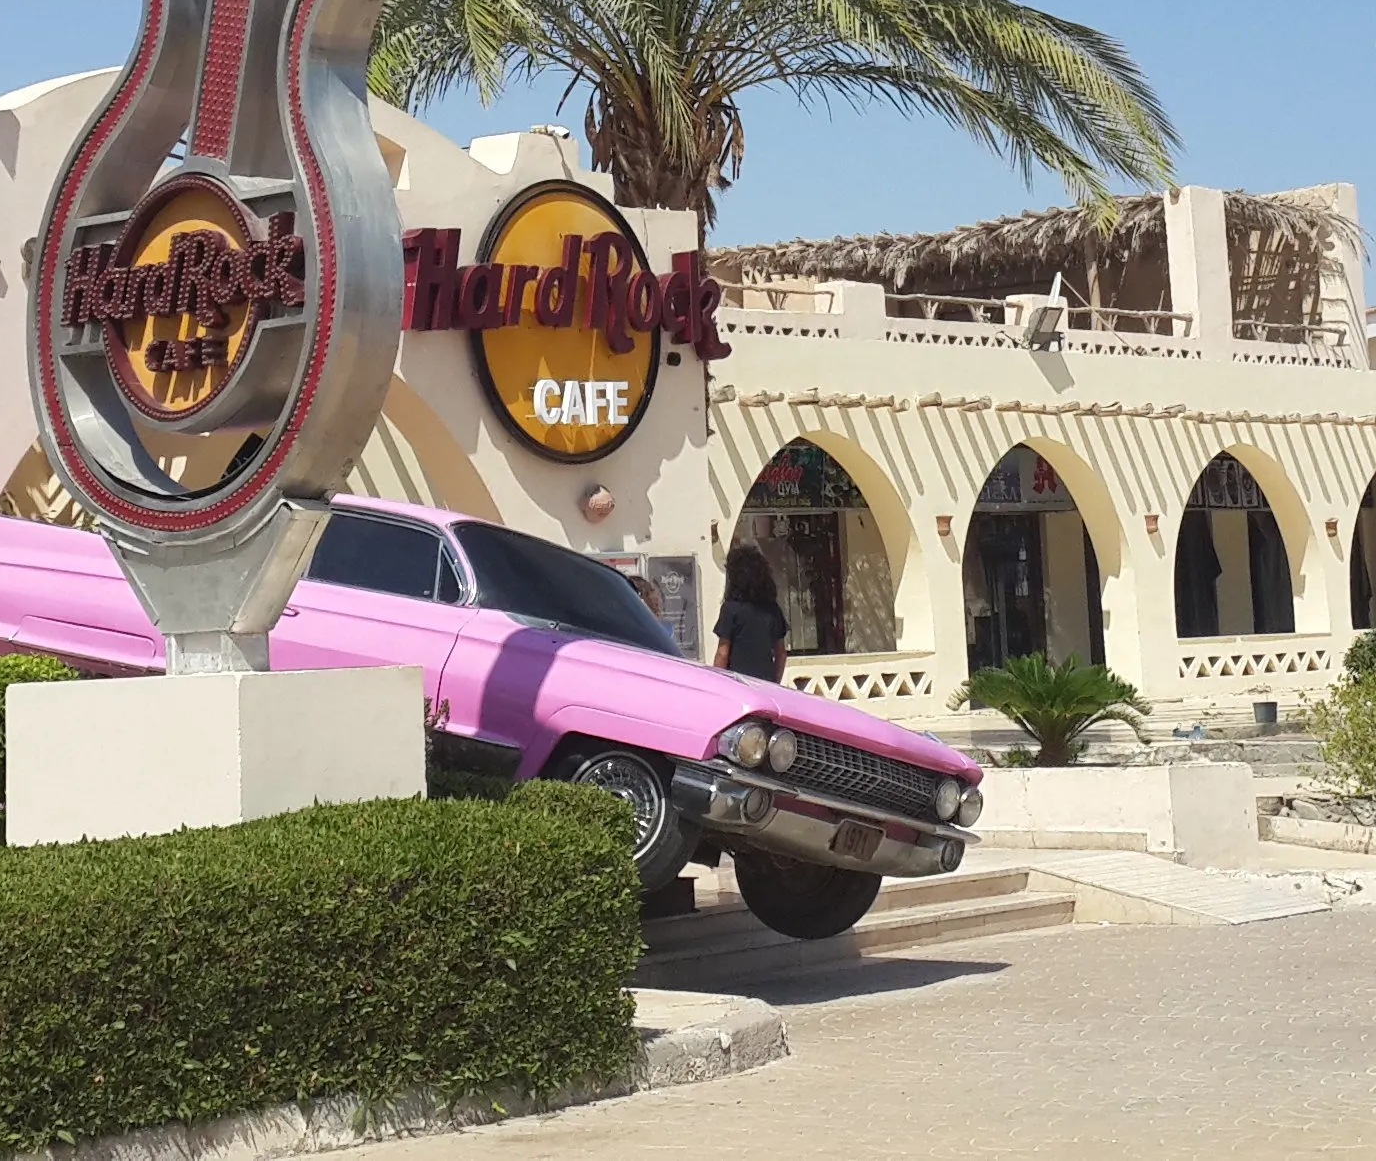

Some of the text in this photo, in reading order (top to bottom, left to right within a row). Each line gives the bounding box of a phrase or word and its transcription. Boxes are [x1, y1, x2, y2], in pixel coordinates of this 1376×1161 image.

[402, 228, 732, 360] Hard Rock
[145, 336, 230, 373] CAFE
[533, 379, 630, 426] CAFE
